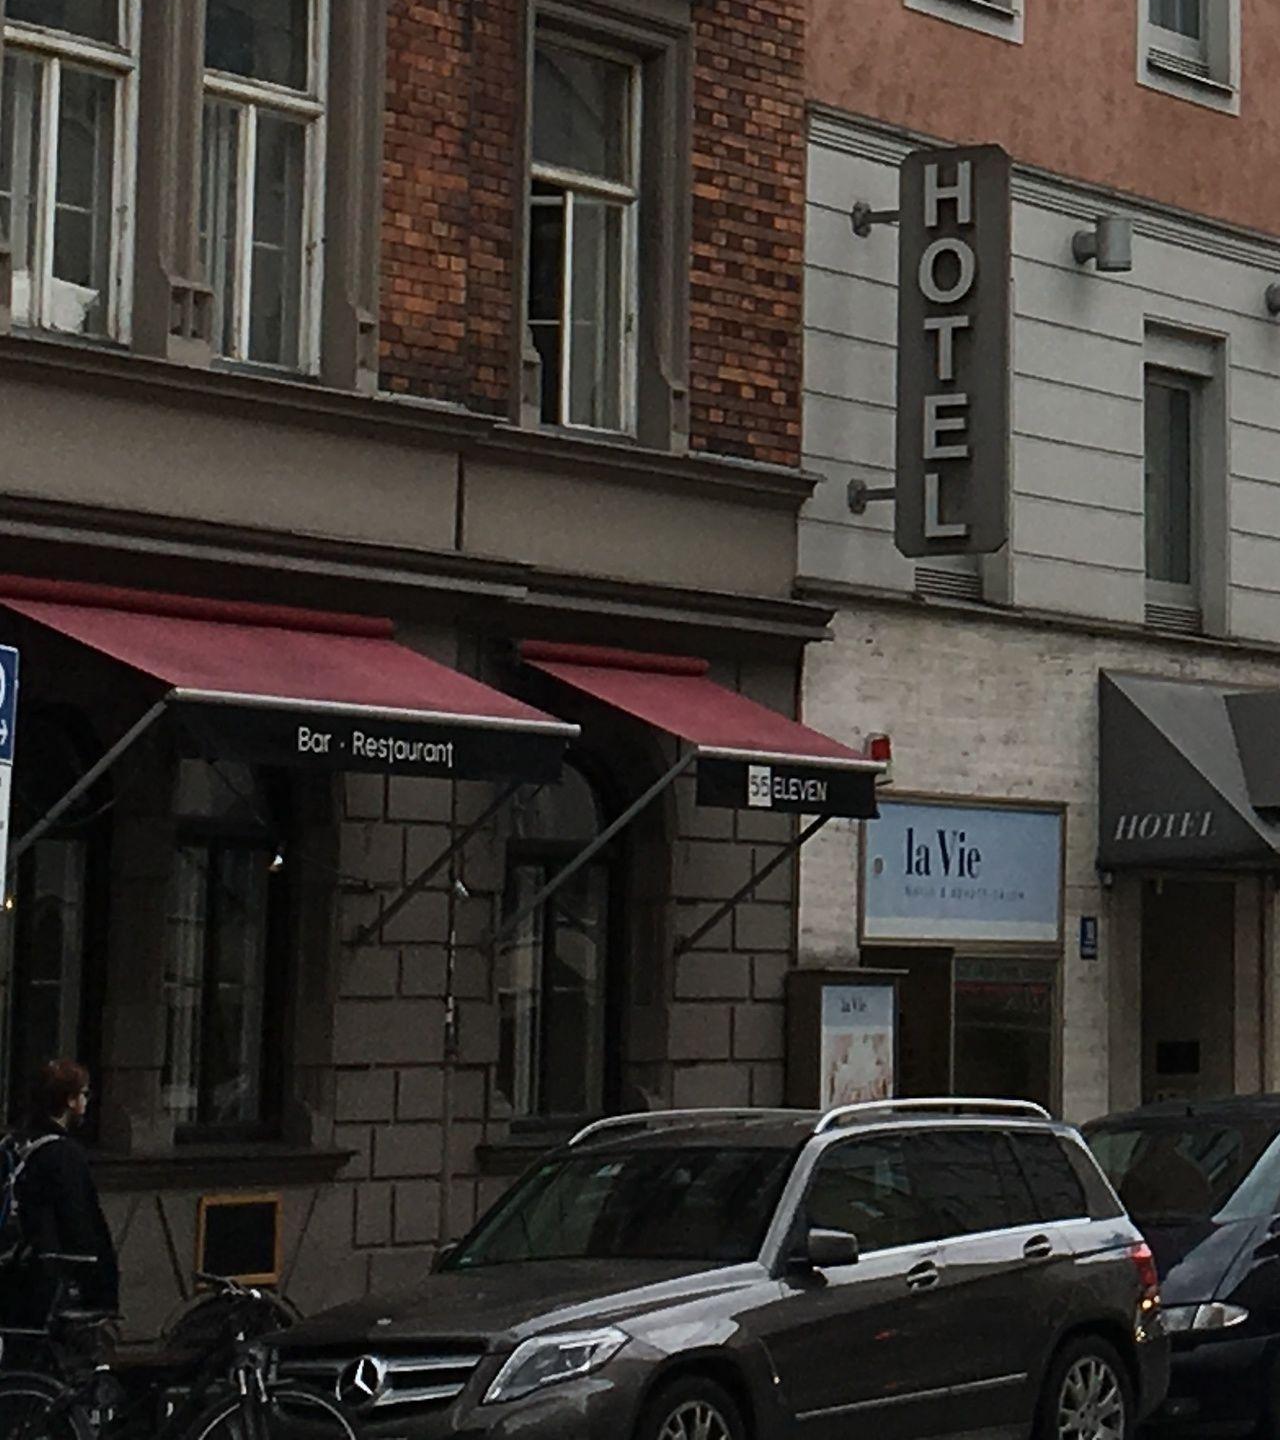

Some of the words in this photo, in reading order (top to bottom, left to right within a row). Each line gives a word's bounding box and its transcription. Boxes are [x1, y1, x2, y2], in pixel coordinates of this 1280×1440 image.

[917, 160, 976, 539] HOTEL
[298, 726, 330, 753] Bar
[352, 735, 454, 768] Restaurant
[773, 776, 827, 801] ELEVEN
[1114, 811, 1218, 841] HOTEL
[904, 827, 931, 876] la
[937, 828, 982, 879] Vie
